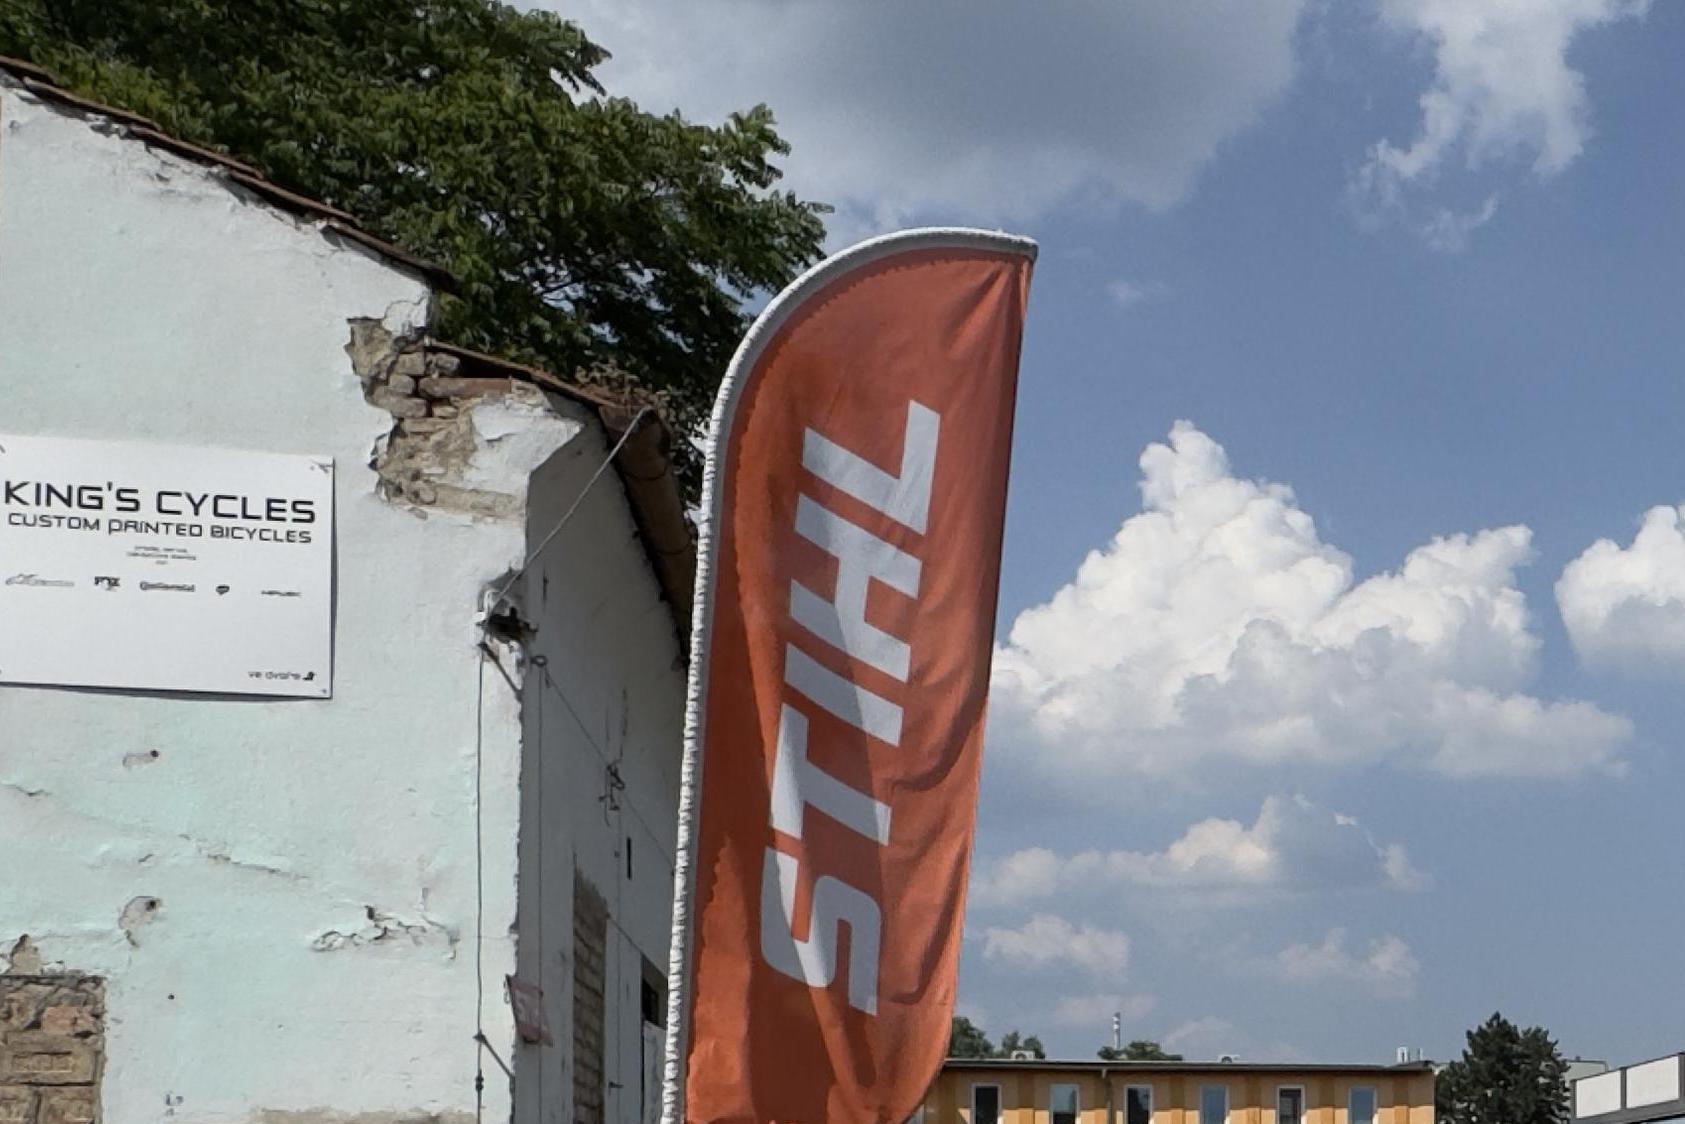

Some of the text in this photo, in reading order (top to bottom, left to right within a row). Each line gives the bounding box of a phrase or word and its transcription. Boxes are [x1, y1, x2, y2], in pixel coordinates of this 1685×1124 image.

[4, 481, 316, 524] KING'S CYCLES
[8, 512, 312, 544] CUSTOM PAINTED BICYCLES
[761, 400, 941, 1016] STIHL
